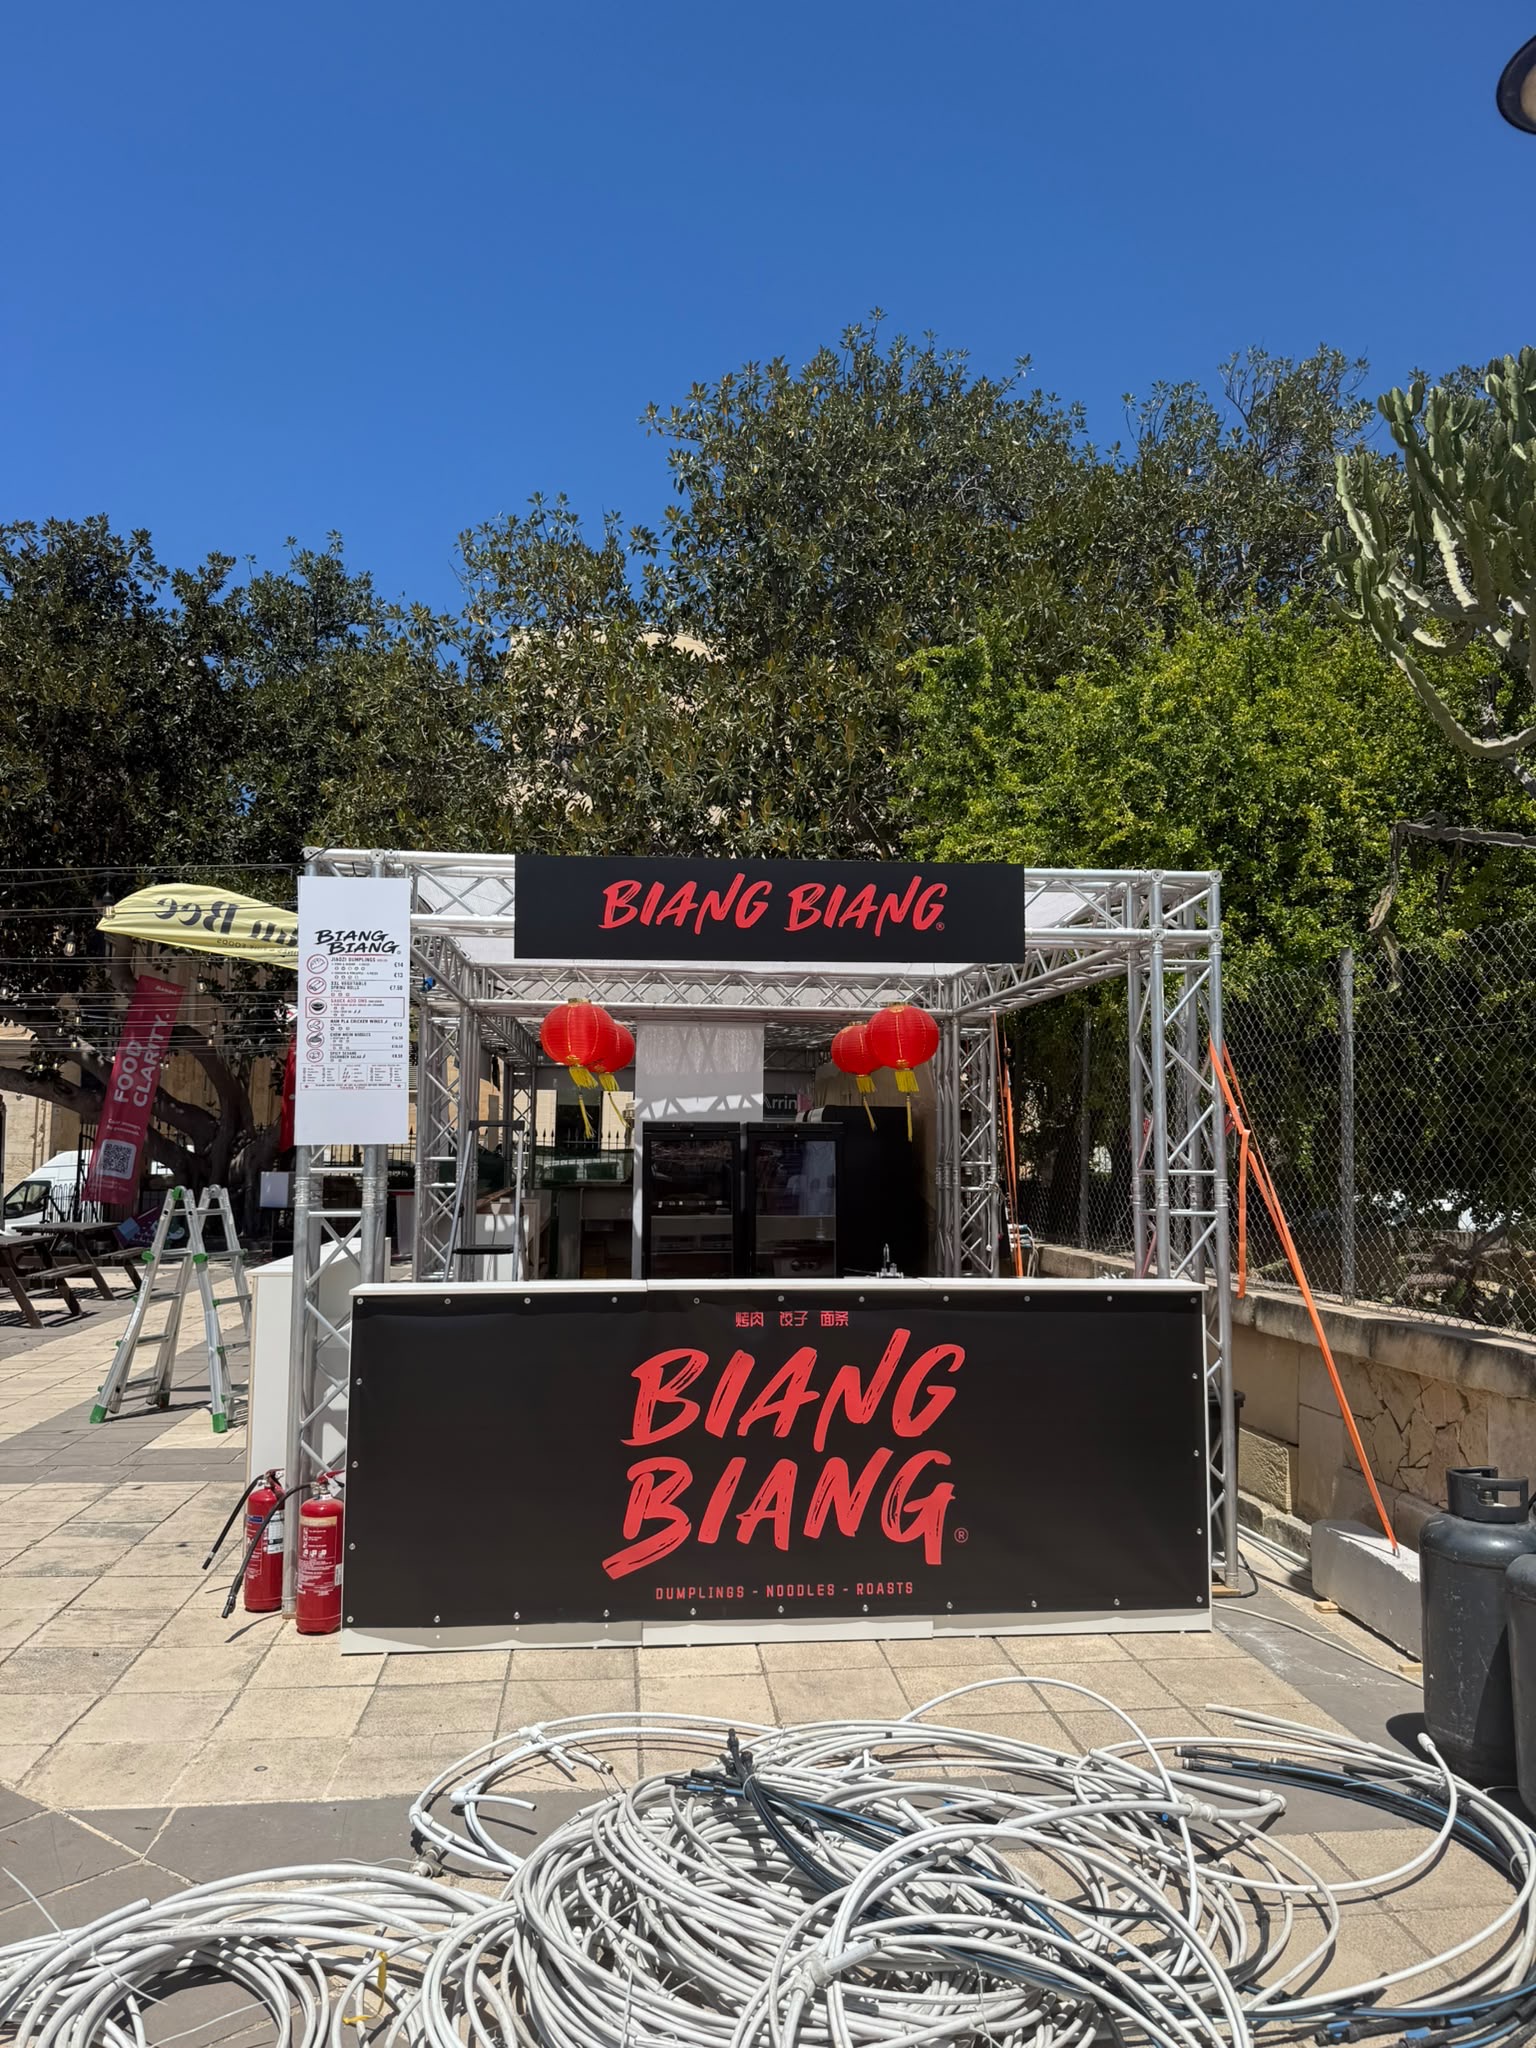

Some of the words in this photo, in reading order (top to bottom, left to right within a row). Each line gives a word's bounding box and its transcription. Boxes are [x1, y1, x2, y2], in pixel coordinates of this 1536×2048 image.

[598, 873, 773, 935] BIANG
[784, 876, 948, 937] BIANG
[314, 929, 389, 945] BIANG
[326, 941, 400, 956] BIANG
[113, 1040, 143, 1103] FOOD
[735, 1311, 764, 1328] 烤肉
[820, 1310, 849, 1327] 面条
[620, 1328, 966, 1453] BIANG
[602, 1447, 957, 1580] BIANG
[655, 1585, 745, 1600] DUMPLINGS
[765, 1583, 836, 1598] NOODLES
[856, 1581, 914, 1596] ROASTS
